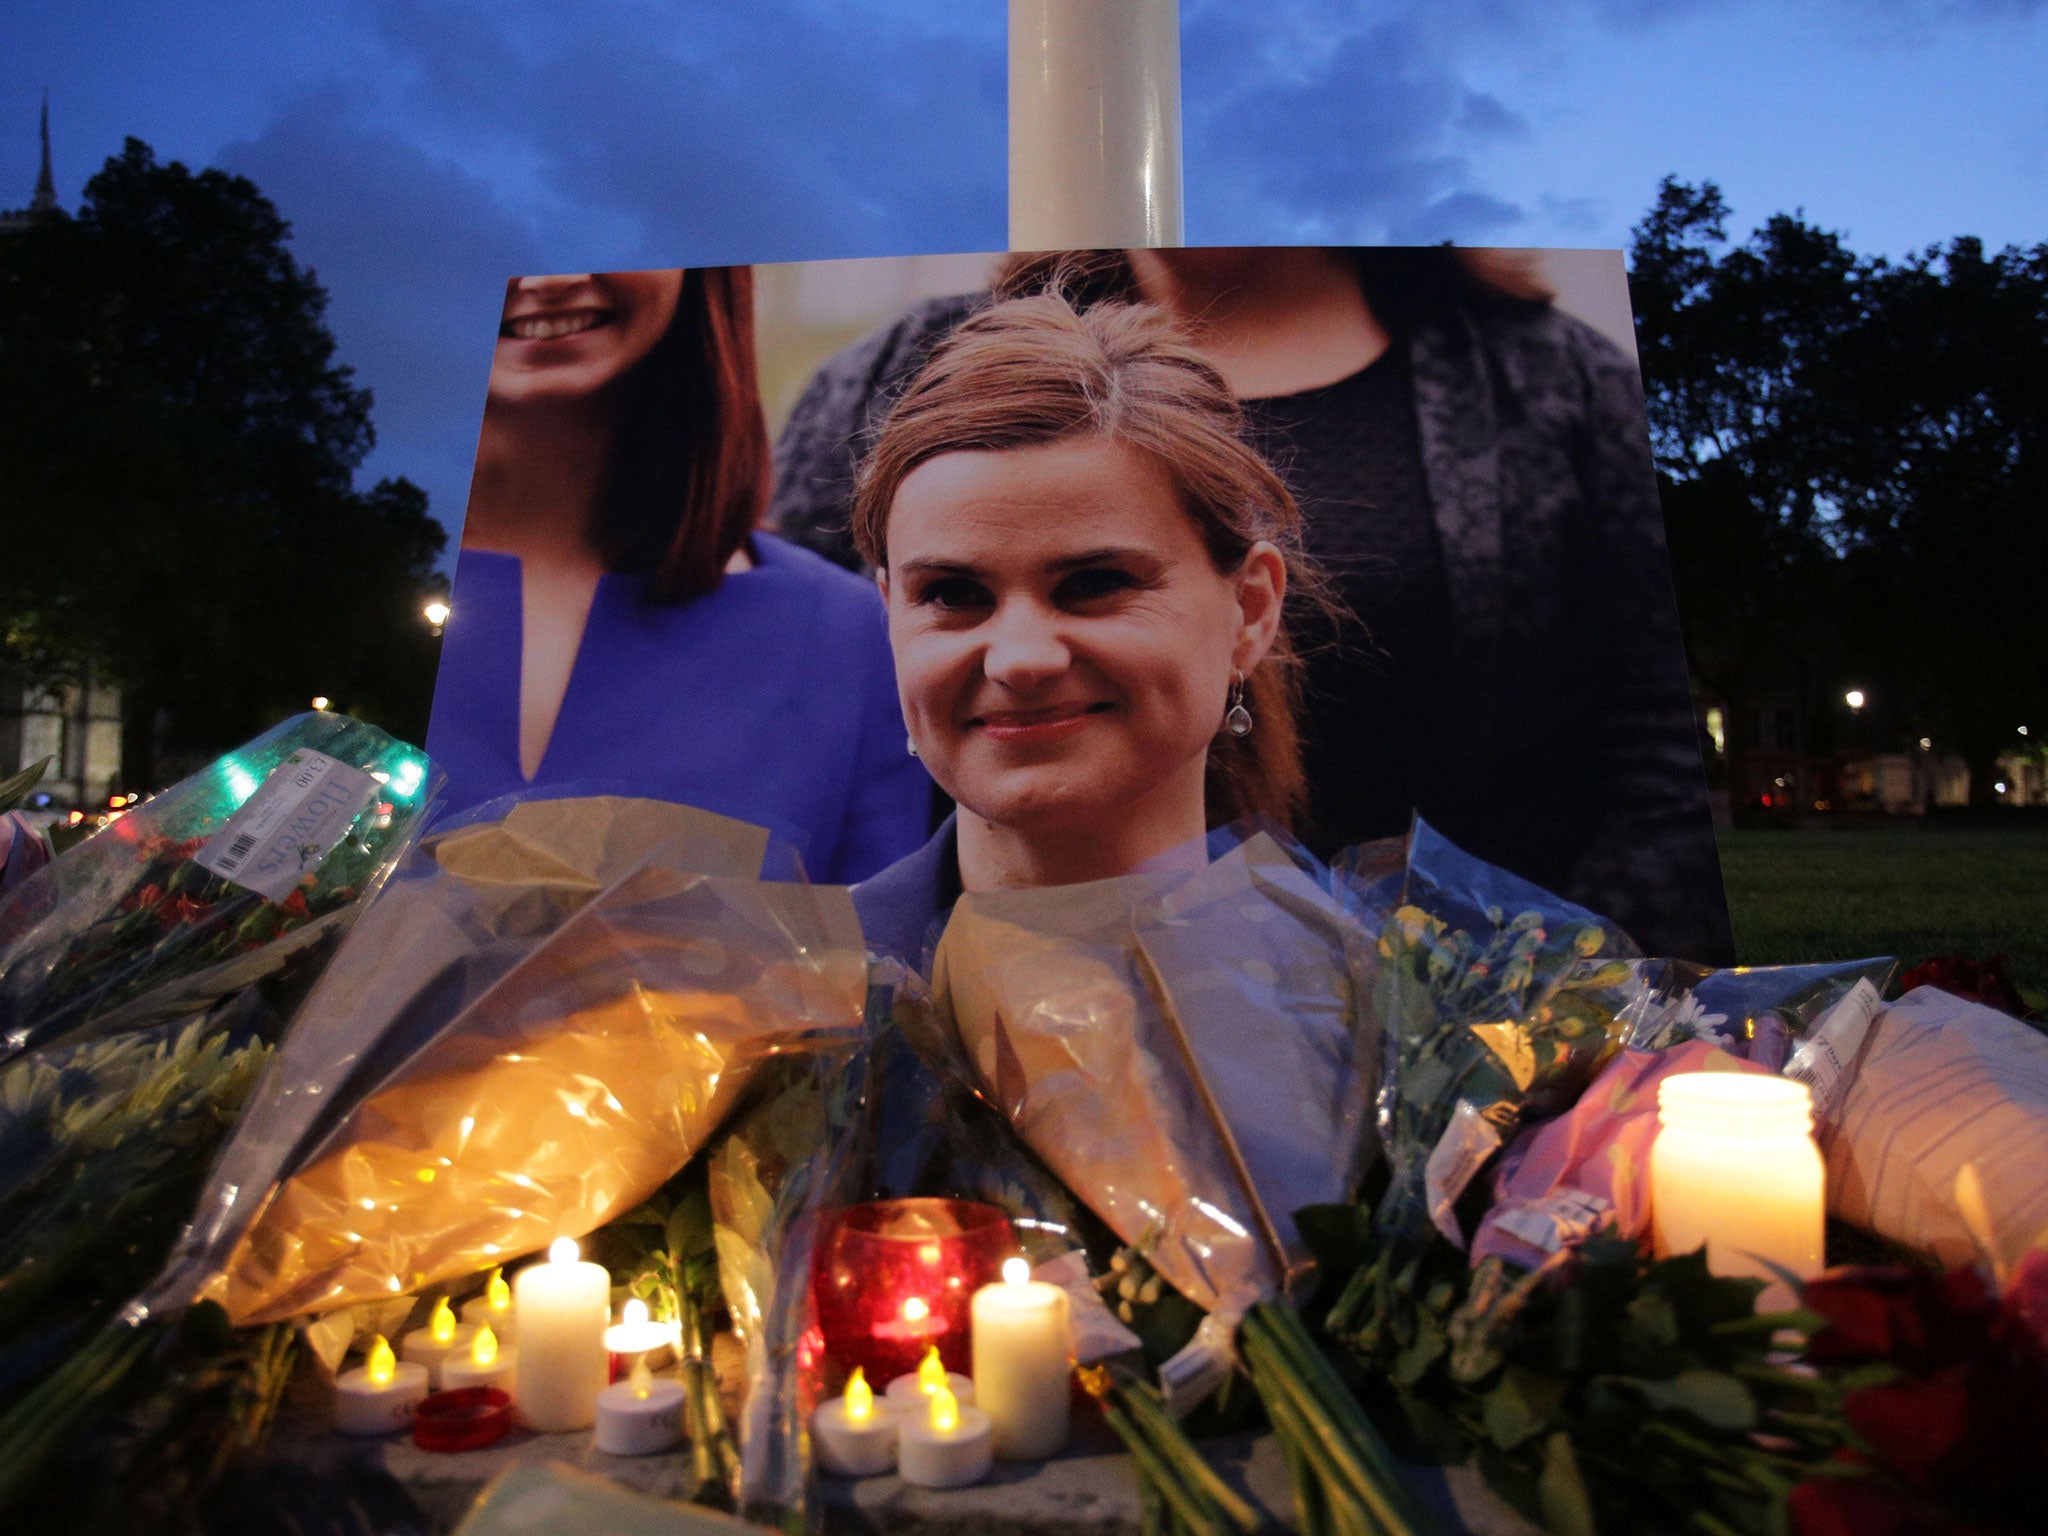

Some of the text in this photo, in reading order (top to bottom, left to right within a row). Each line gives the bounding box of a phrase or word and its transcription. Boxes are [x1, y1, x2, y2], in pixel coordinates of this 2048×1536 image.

[296, 757, 327, 788] £3.00
[257, 780, 352, 873] flowers
[1818, 1035, 1829, 1046] 7
